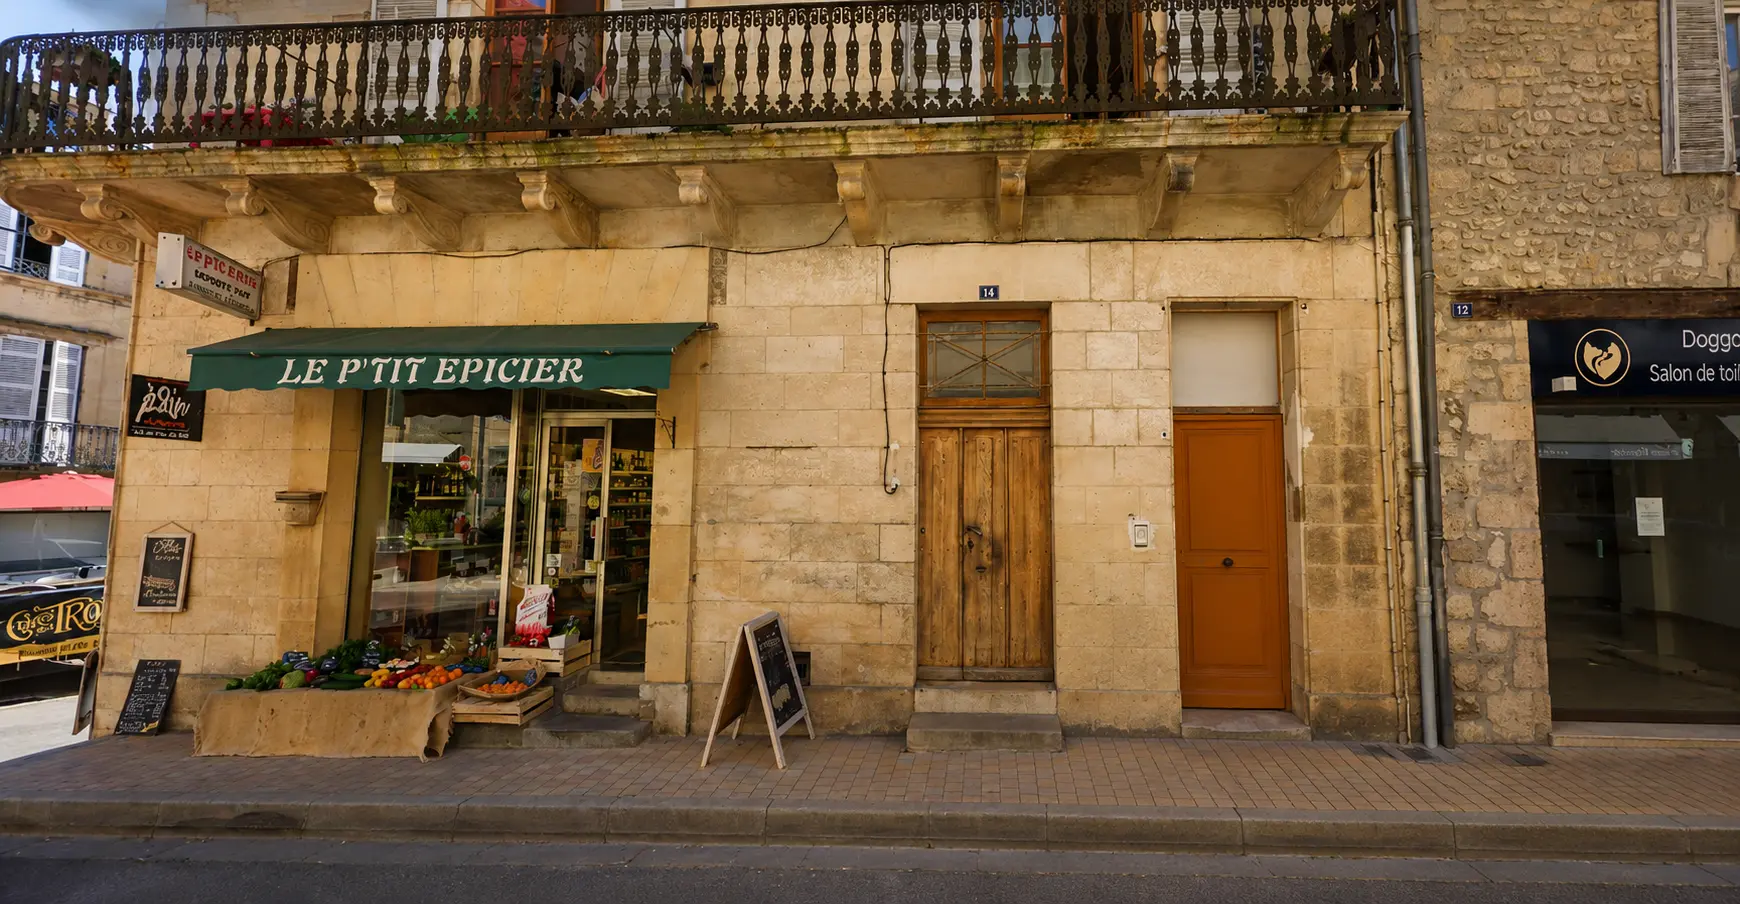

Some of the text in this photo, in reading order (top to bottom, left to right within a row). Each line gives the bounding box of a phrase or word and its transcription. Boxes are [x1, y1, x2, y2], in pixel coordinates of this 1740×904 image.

[984, 288, 995, 298] 14
[1457, 305, 1469, 315] 12
[276, 356, 585, 385] LE P'TIT EPICIER
[1650, 363, 1693, 382] Salon
[1696, 363, 1716, 382] de
